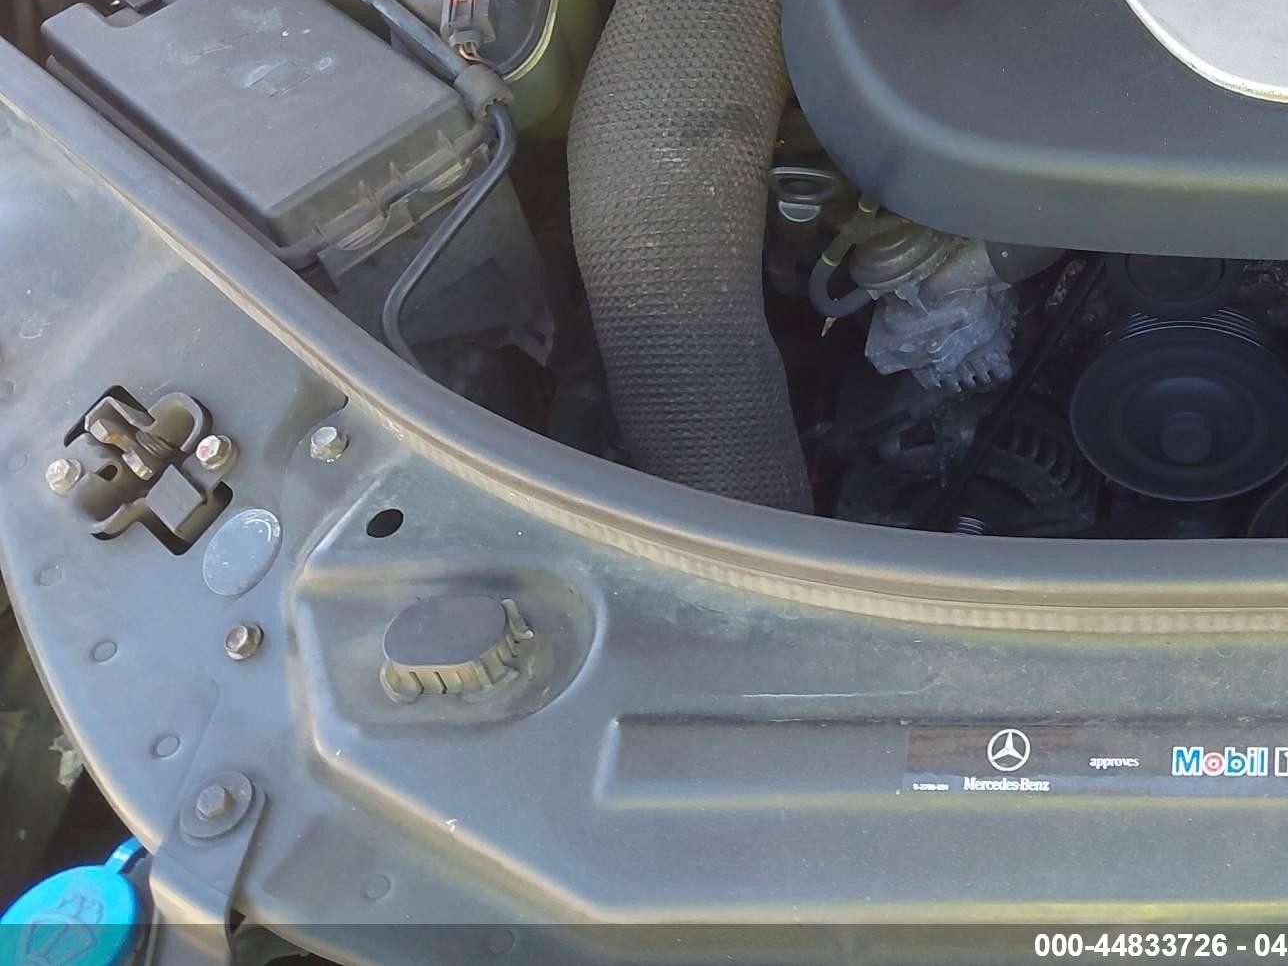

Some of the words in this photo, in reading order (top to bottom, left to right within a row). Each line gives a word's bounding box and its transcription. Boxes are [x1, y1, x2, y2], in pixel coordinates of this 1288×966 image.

[1089, 757, 1139, 769] approves
[1172, 746, 1268, 777] Mobil
[963, 776, 1050, 791] Mercedes-Benz
